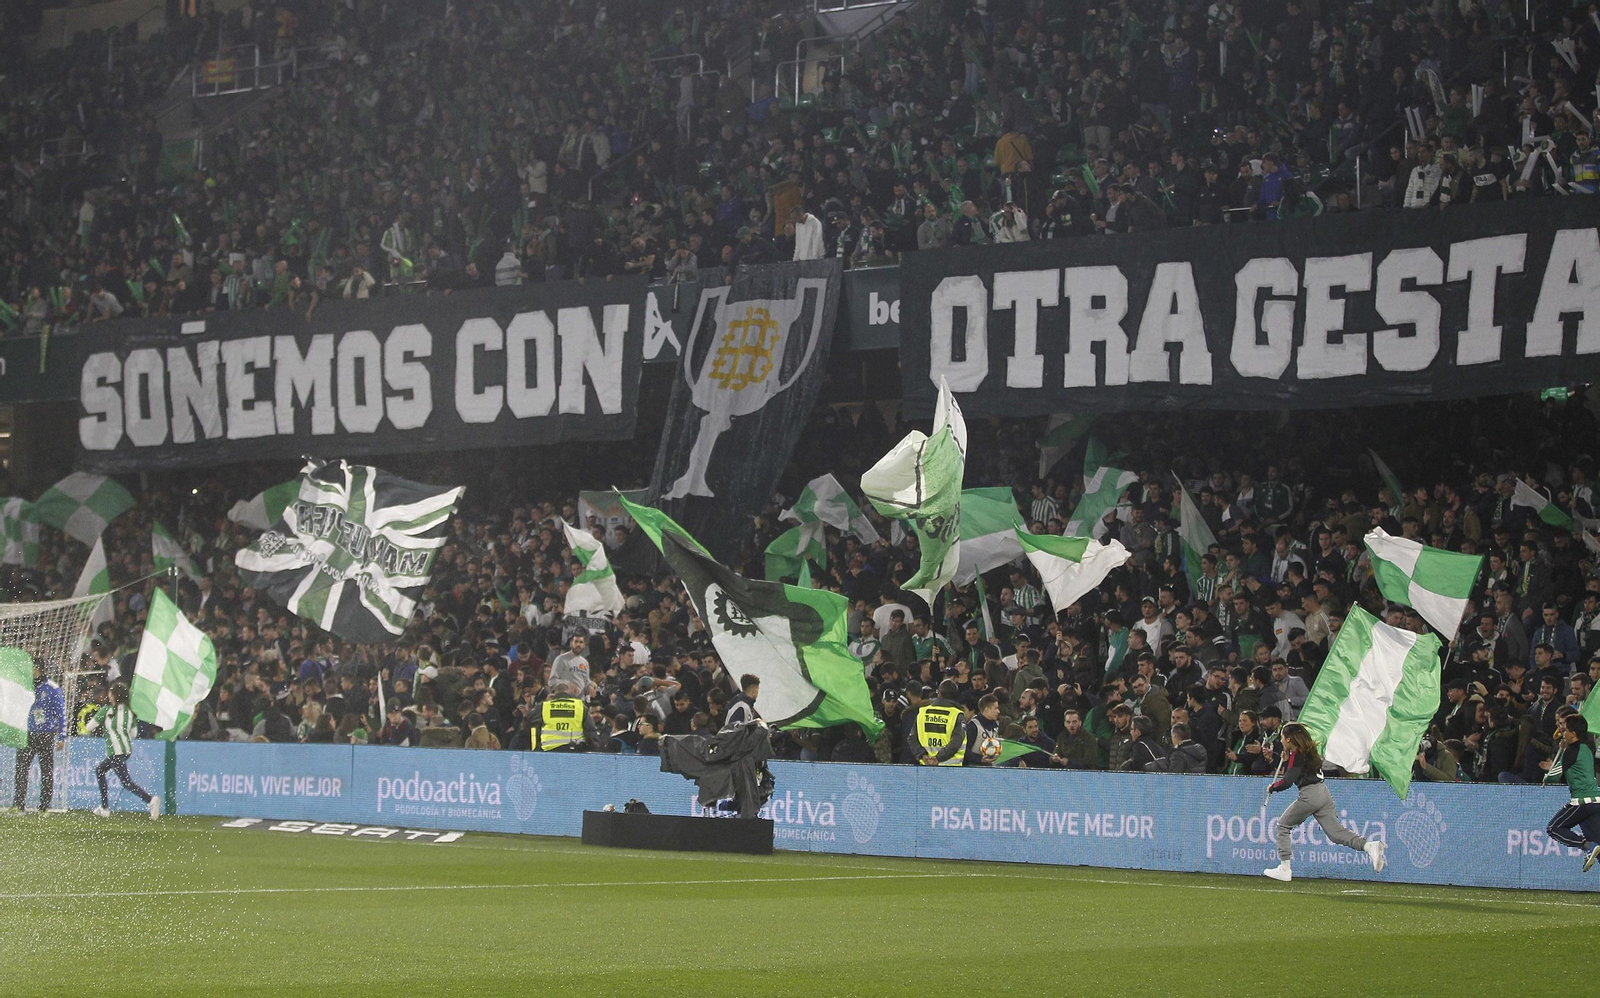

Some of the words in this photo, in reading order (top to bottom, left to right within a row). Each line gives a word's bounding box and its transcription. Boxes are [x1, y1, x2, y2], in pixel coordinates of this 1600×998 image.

[930, 262, 1212, 392] OTRA
[1230, 228, 1600, 380] GESTA
[79, 321, 432, 450] SOÑEMOS
[455, 304, 629, 423] CON
[556, 723, 570, 731] 027
[925, 714, 949, 724] Trablisa
[928, 737, 943, 748] 084
[188, 773, 218, 794] PISA
[222, 774, 257, 798] BIEN,
[261, 774, 291, 797] VIVE
[293, 776, 342, 799] MEJOR
[377, 771, 502, 812] podoactiva
[395, 803, 440, 816] PODOLOGÍA
[448, 806, 502, 819] BIOMECÁNICA
[268, 820, 441, 841] SEAT
[932, 806, 975, 830] PISA
[980, 809, 1032, 837] BIEN,
[1036, 811, 1080, 835] VIVE
[1084, 813, 1154, 840] MEJOR
[1507, 828, 1562, 857] PISA
[1300, 850, 1307, 862] Y
